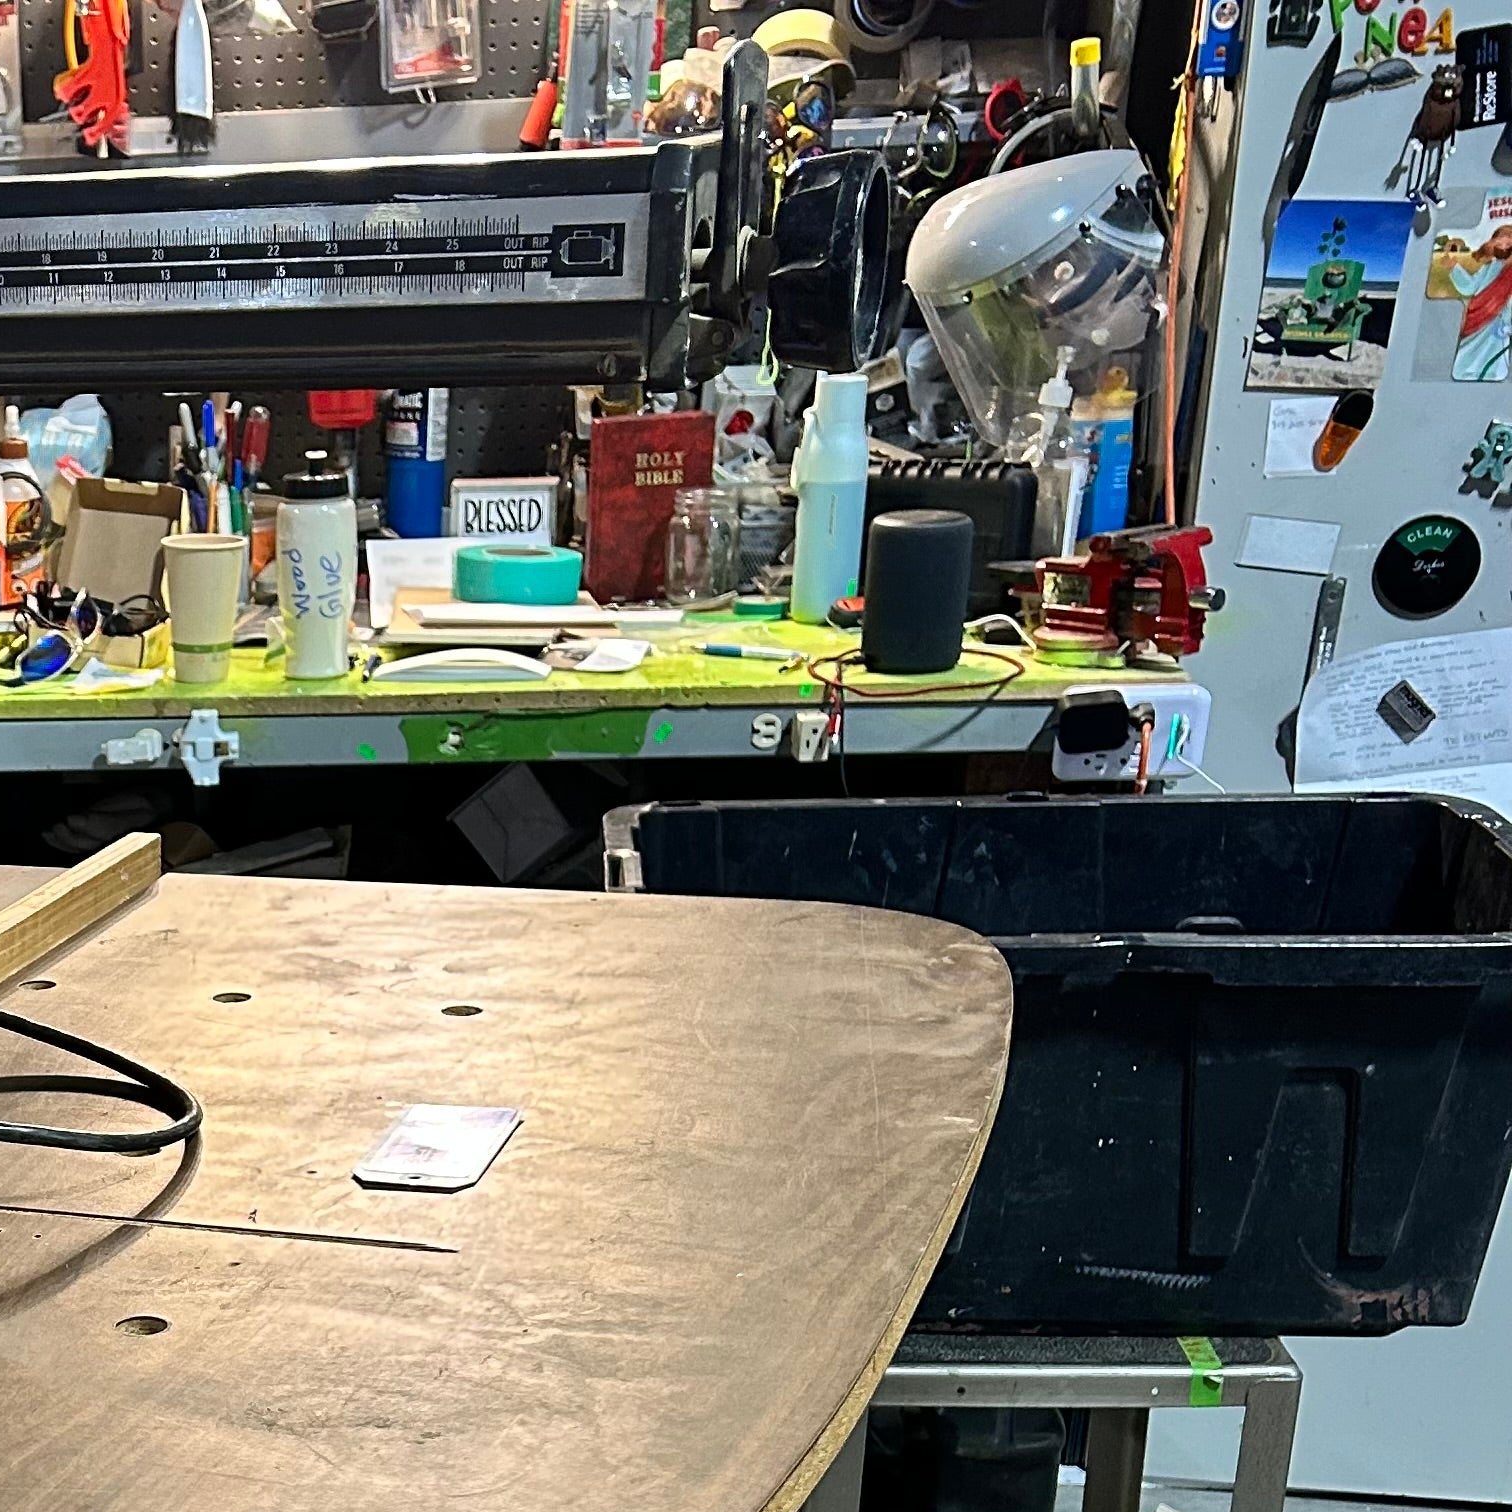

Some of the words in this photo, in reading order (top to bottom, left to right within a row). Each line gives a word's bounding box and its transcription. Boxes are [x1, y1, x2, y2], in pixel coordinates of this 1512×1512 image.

[1483, 71, 1497, 121] ReStore
[41, 253, 52, 264] 18
[97, 251, 108, 262] 19
[152, 249, 164, 261] 20
[209, 247, 220, 259] 21
[267, 245, 280, 257] 22
[325, 243, 339, 255] 23
[385, 241, 399, 252] 24
[446, 239, 459, 250] 25
[504, 237, 524, 250] OUT
[532, 236, 550, 248] RIP
[49, 273, 59, 285] 11
[103, 271, 114, 283] 12
[160, 269, 171, 281] 13
[216, 267, 227, 279] 14
[275, 265, 286, 278] 15
[334, 263, 344, 276] 16
[394, 261, 404, 273] 17
[455, 260, 466, 272] 18
[503, 257, 523, 270] OUT
[530, 256, 548, 268] RIP
[635, 451, 686, 468] HOLY
[635, 469, 684, 486] BIBLE
[464, 499, 542, 533] BLESSED
[1407, 526, 1453, 543] CLEAN
[282, 548, 310, 619] Wood
[317, 550, 344, 618] Glue
